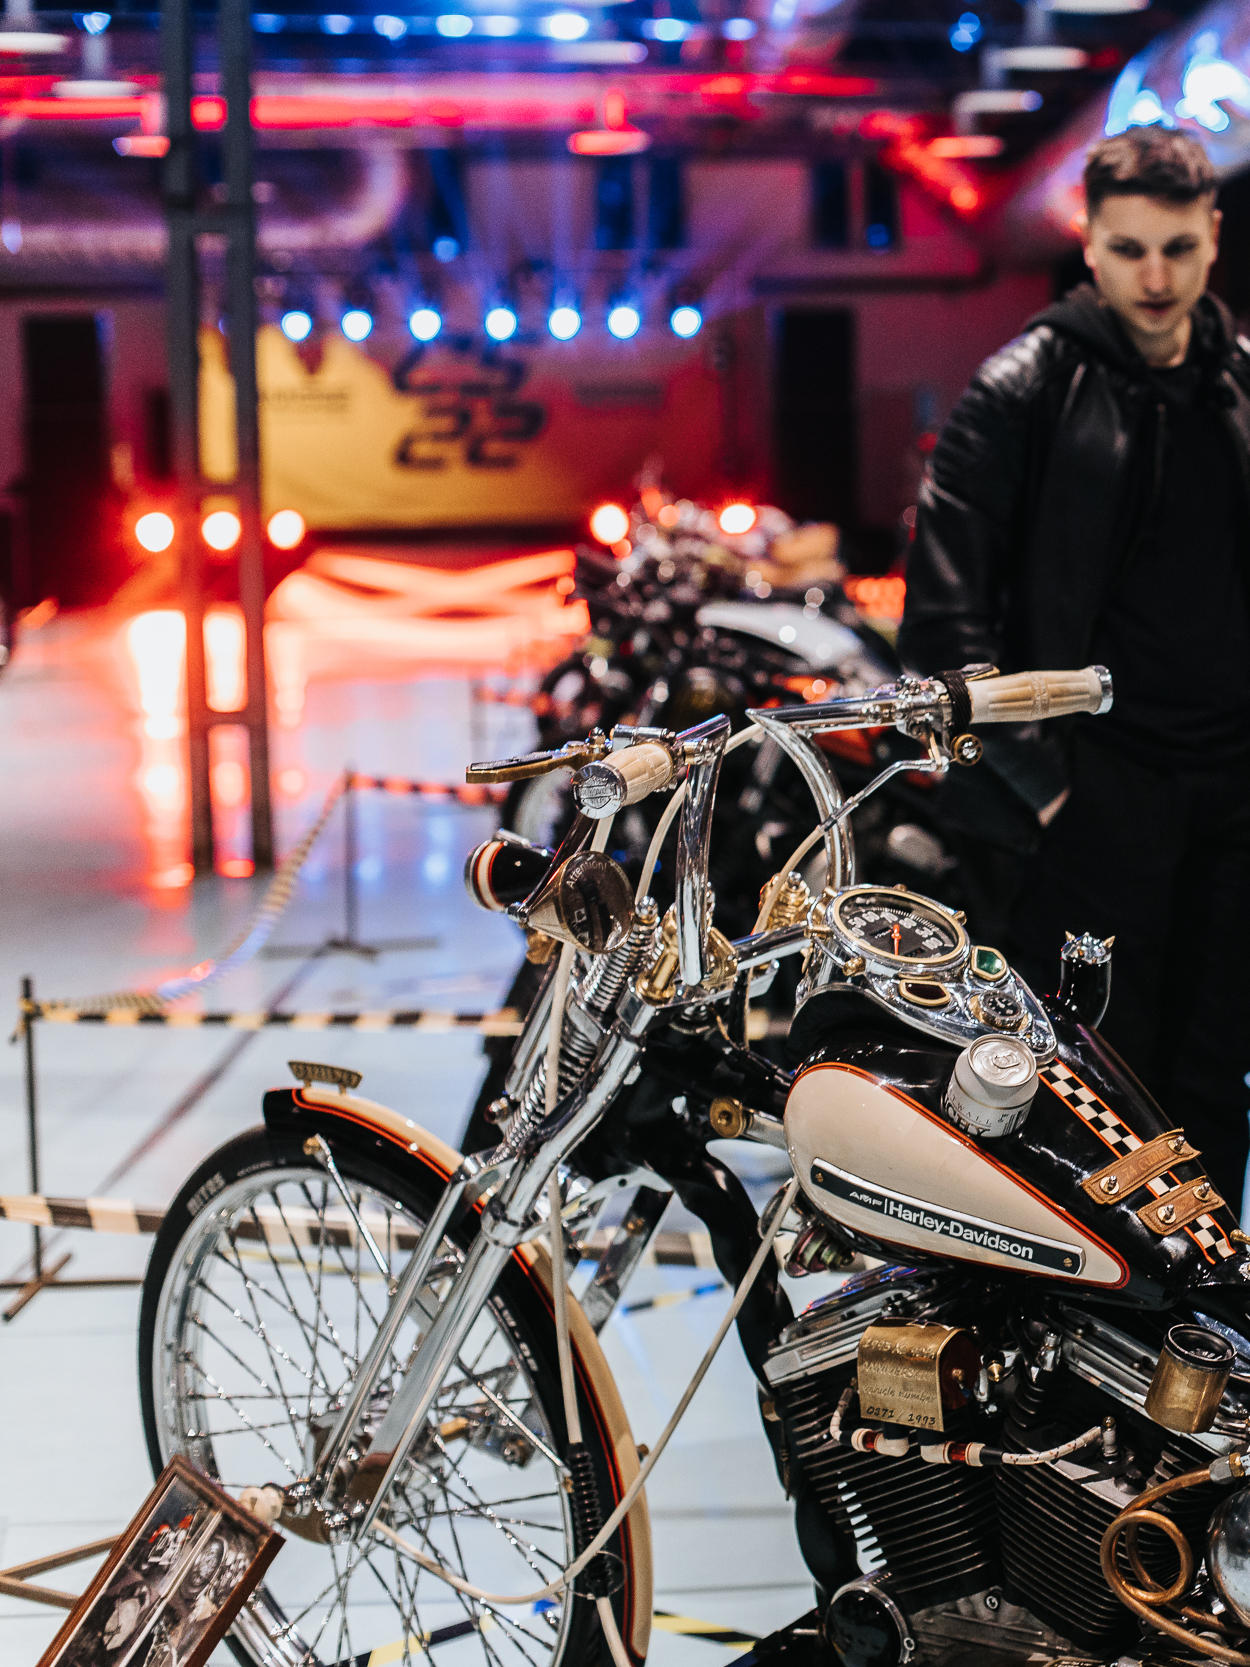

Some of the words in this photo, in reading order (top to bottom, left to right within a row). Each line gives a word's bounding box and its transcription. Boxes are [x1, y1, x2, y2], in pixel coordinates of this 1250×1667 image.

[566, 860, 607, 889] Attention!
[849, 1191, 883, 1207] AMF
[888, 1200, 1034, 1261] Harley-Davidson
